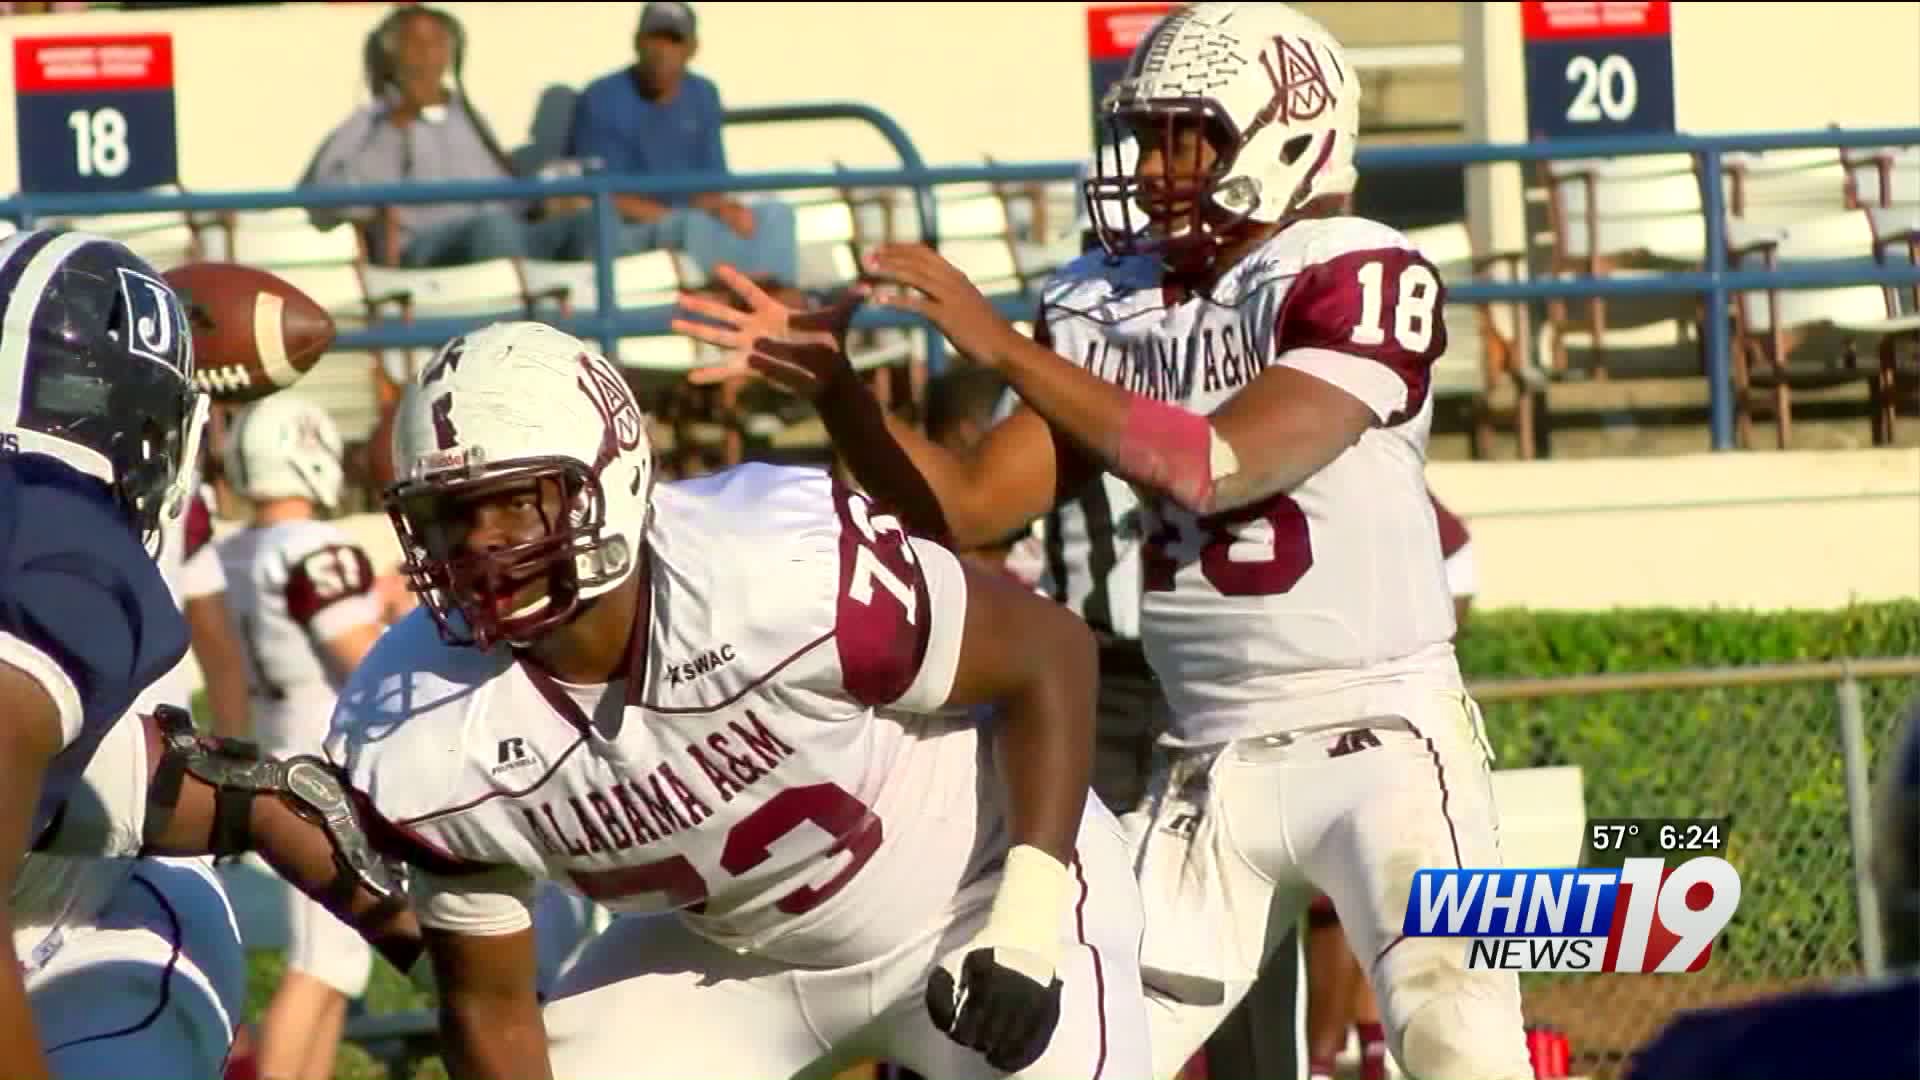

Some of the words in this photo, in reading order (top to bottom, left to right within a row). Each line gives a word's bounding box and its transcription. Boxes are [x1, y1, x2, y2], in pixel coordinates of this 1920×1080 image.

[1565, 55, 1638, 121] 20
[68, 107, 130, 176] 18
[138, 282, 171, 353] J
[1350, 261, 1439, 352] 18
[685, 643, 736, 681] SWAC
[523, 761, 715, 857] ALABAMA
[686, 709, 796, 803] A&M
